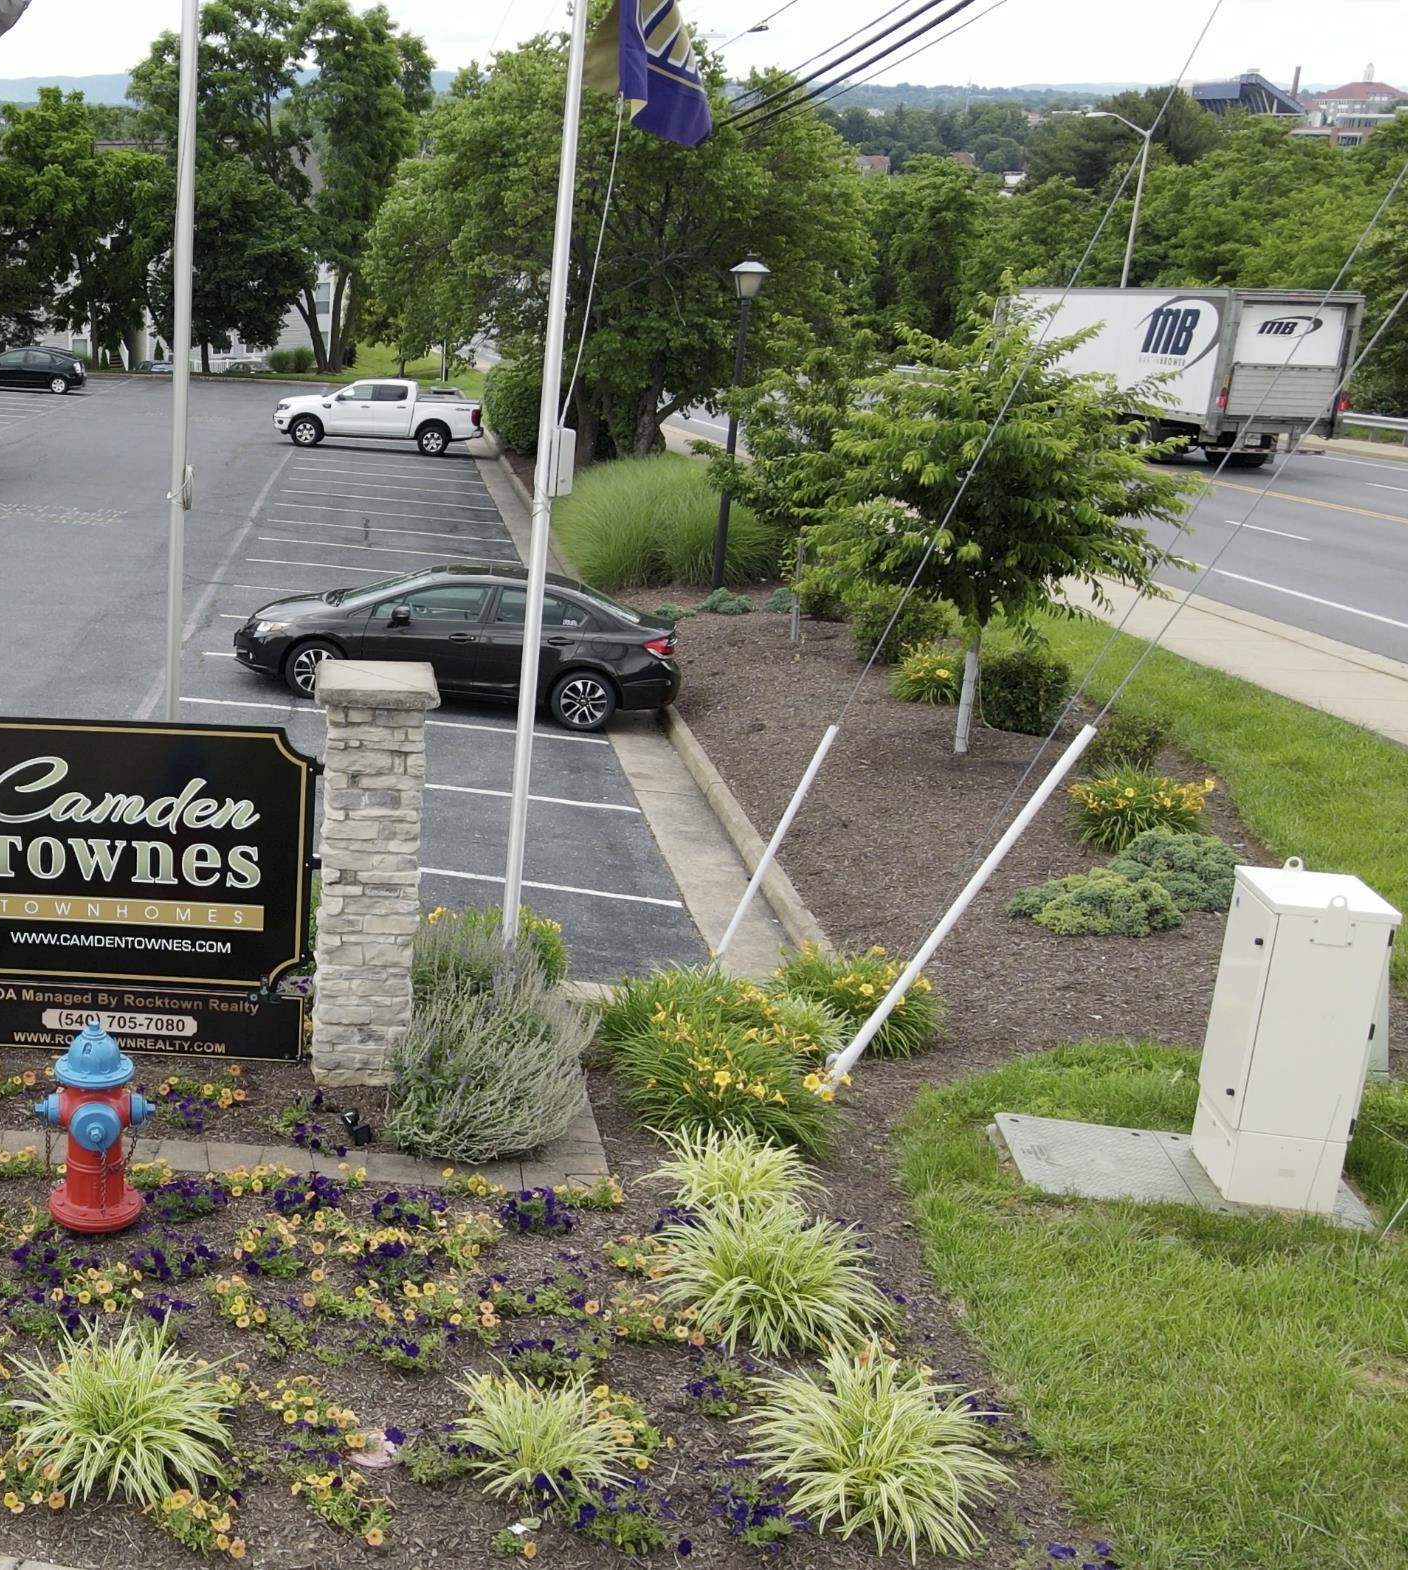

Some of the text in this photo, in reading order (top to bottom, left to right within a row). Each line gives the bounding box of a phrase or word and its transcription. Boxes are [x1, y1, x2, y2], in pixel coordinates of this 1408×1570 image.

[1140, 308, 1200, 355] MB
[1258, 321, 1298, 334] MB
[0, 899, 244, 924] TOWNHOMES
[10, 931, 232, 954] WWW.CAMDENTOWNES.COM
[22, 989, 92, 1006] Managed
[98, 992, 118, 1008] By
[124, 994, 203, 1010] Rocktown
[209, 999, 260, 1016] Realty
[107, 1015, 186, 1032] 705-7080
[13, 1031, 226, 1054] WWW.ROWNREALTY.COM
